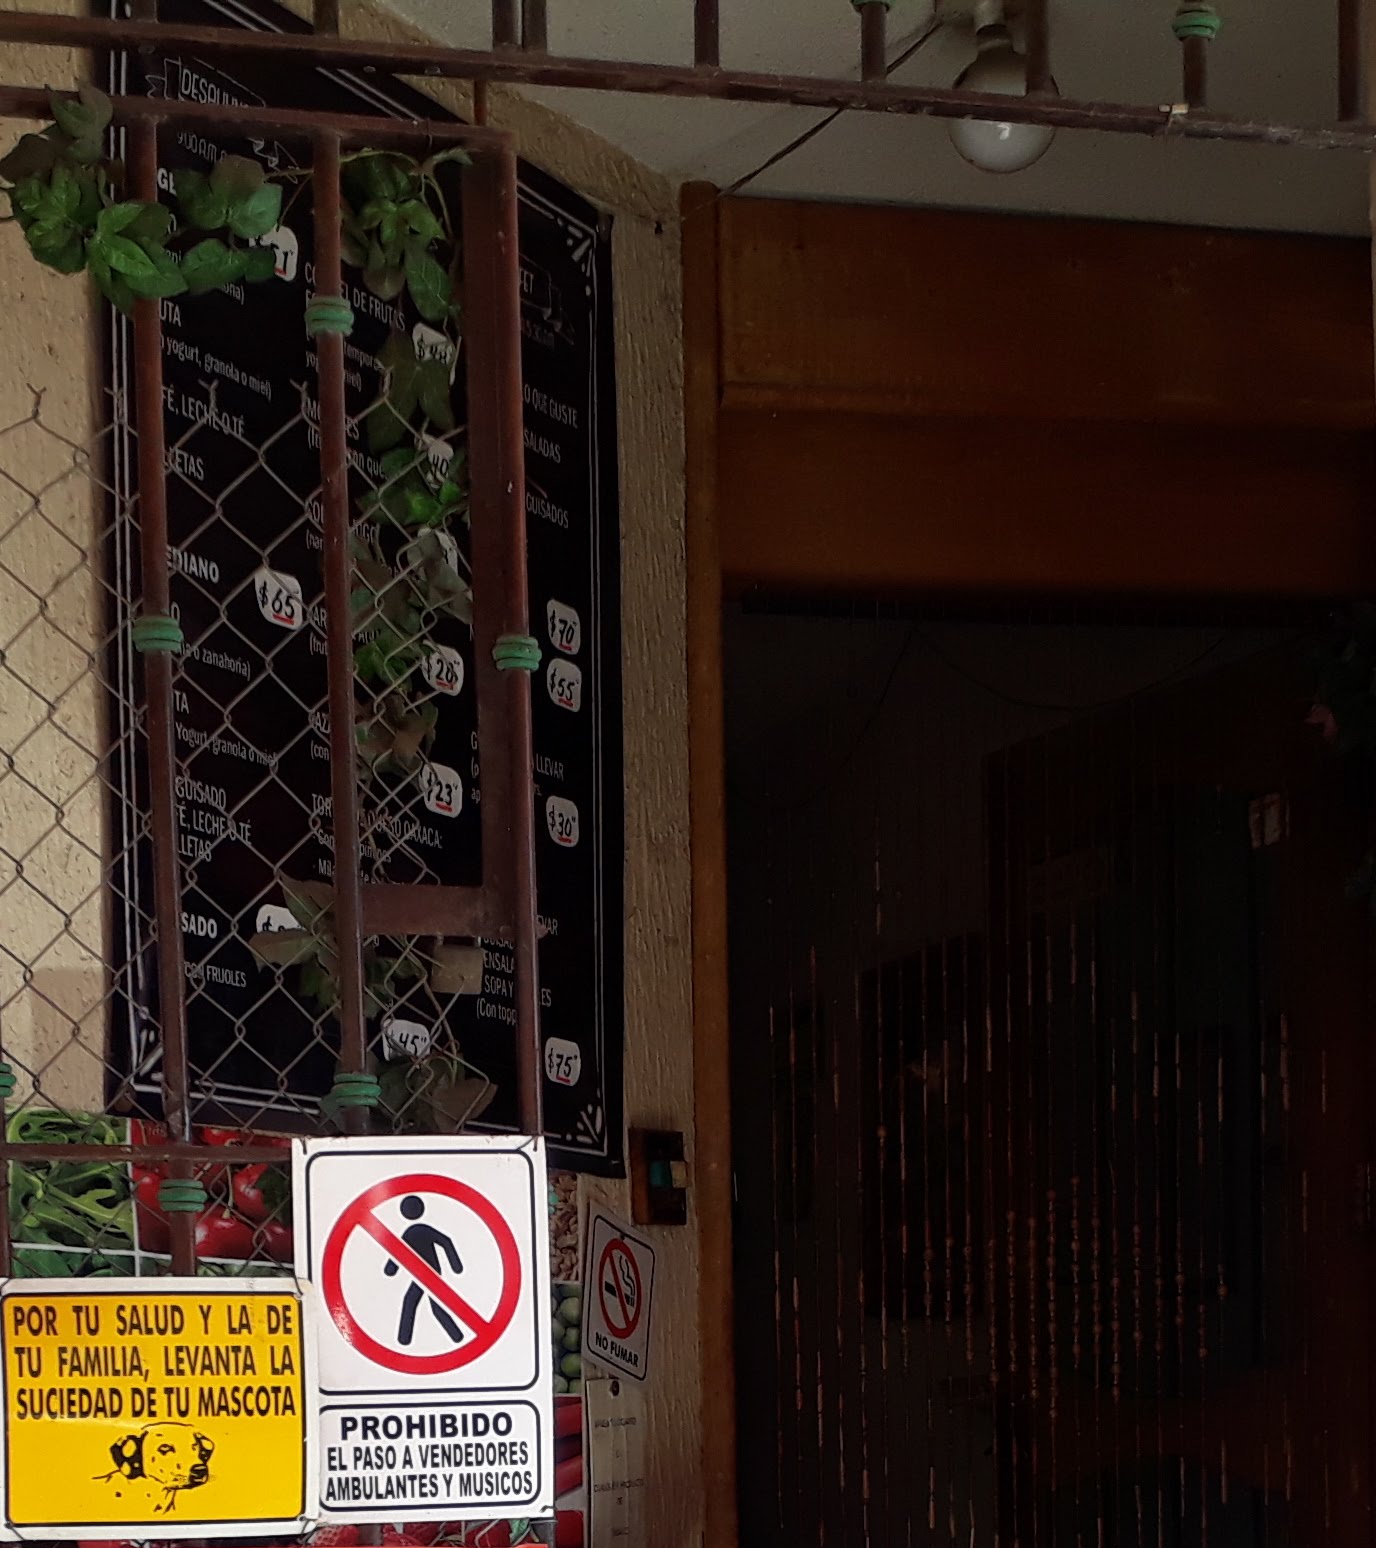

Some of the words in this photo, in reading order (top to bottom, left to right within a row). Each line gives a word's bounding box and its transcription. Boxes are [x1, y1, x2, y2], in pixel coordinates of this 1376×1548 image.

[159, 299, 181, 327] UTA
[549, 397, 578, 430] GUSTE
[523, 425, 562, 465] SALADAS
[526, 493, 570, 530] GUISADOS
[175, 775, 227, 812] GUISADO
[177, 823, 212, 863] LETAS
[180, 911, 218, 940] SADO
[206, 964, 247, 989] FRIJOLES
[484, 976, 508, 995] SOPA
[14, 1305, 58, 1336] POR
[72, 1305, 100, 1336] TU
[116, 1304, 185, 1336] SALUD
[199, 1304, 212, 1335] Y
[227, 1304, 252, 1335] LA
[266, 1304, 293, 1335] DE
[14, 1346, 42, 1378] TU
[58, 1345, 150, 1382] FAMILIA,
[164, 1345, 256, 1377] LEVANTA
[270, 1345, 295, 1376] LA
[595, 1331, 609, 1350] NO
[610, 1341, 639, 1368] FUMAR
[16, 1387, 123, 1420] SUCIEDAD
[131, 1387, 157, 1418] DE
[164, 1387, 190, 1418] TU
[198, 1385, 296, 1417] MASCOTA
[340, 1411, 513, 1441] PROHIBIDO
[327, 1446, 348, 1471] EL
[353, 1445, 397, 1470] PASO
[402, 1445, 414, 1469] A
[418, 1441, 529, 1468] VENDEDORES
[325, 1473, 439, 1502] AMBULANTES
[442, 1473, 454, 1498] Y
[459, 1470, 533, 1497] MUSICOS
